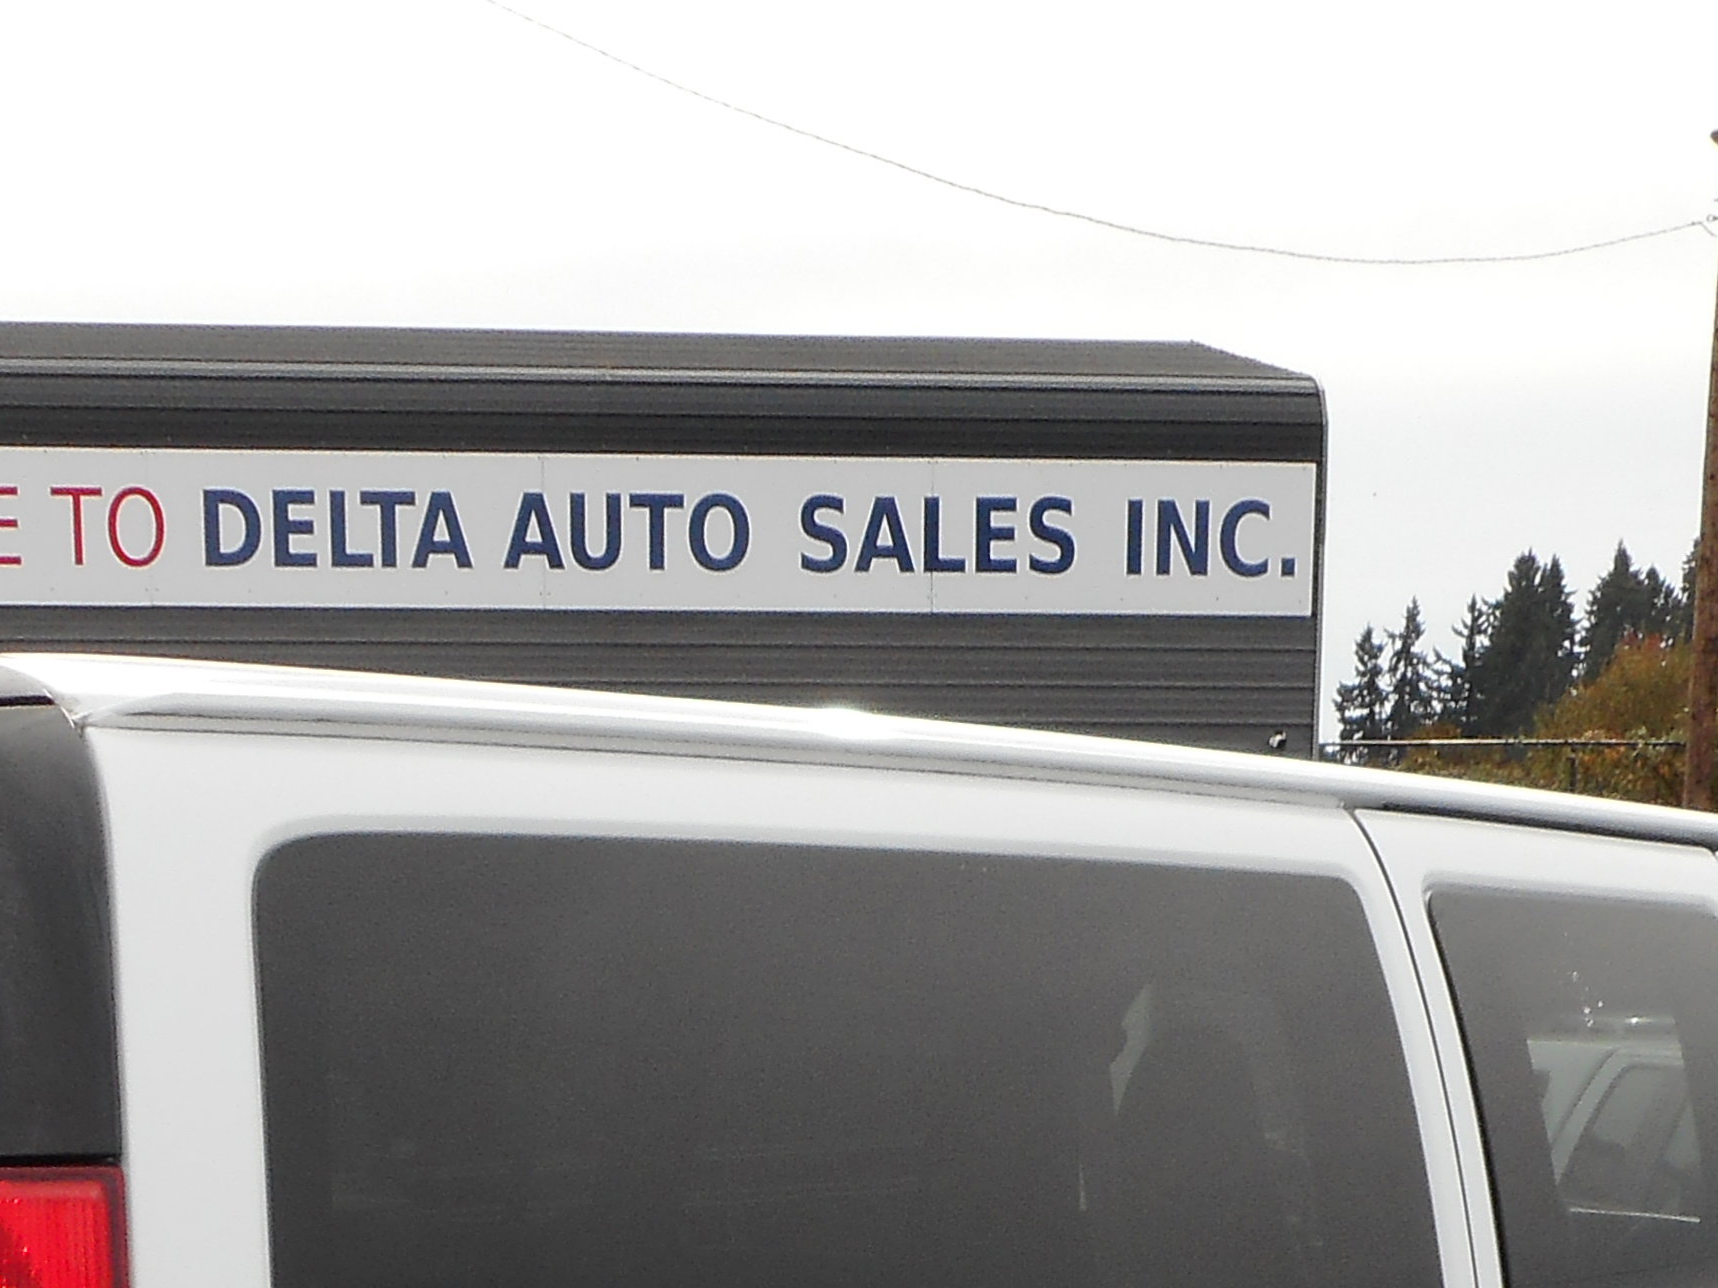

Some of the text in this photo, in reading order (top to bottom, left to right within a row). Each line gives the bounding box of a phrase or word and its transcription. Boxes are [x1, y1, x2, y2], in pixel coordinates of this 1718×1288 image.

[50, 485, 167, 568] TO
[201, 488, 474, 570] DELTA
[502, 492, 751, 573] AUTO
[799, 494, 1076, 575] SALES
[1125, 498, 1297, 578] INC.
